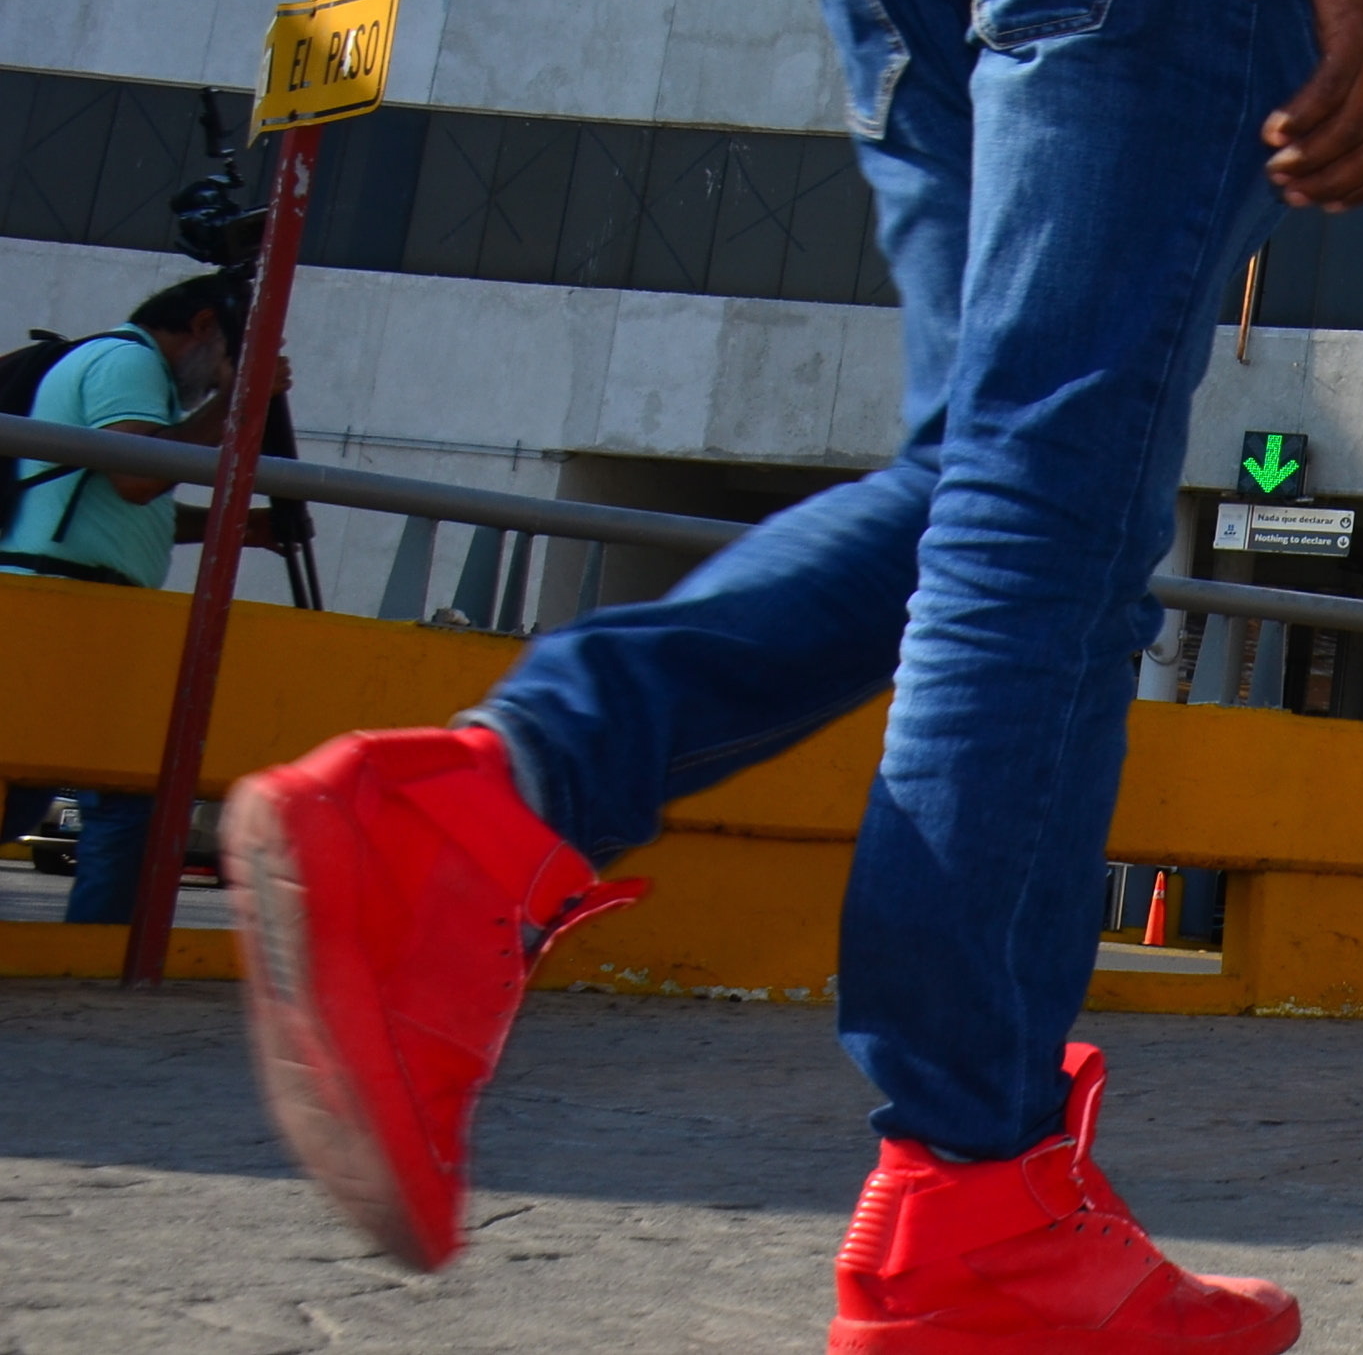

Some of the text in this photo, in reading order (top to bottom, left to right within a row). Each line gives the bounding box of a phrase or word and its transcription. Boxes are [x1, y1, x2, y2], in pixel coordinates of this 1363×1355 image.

[288, 19, 381, 92] EL PASO
[1257, 513, 1334, 525] Nada que declarar
[1254, 533, 1332, 546] Nothing to declare
